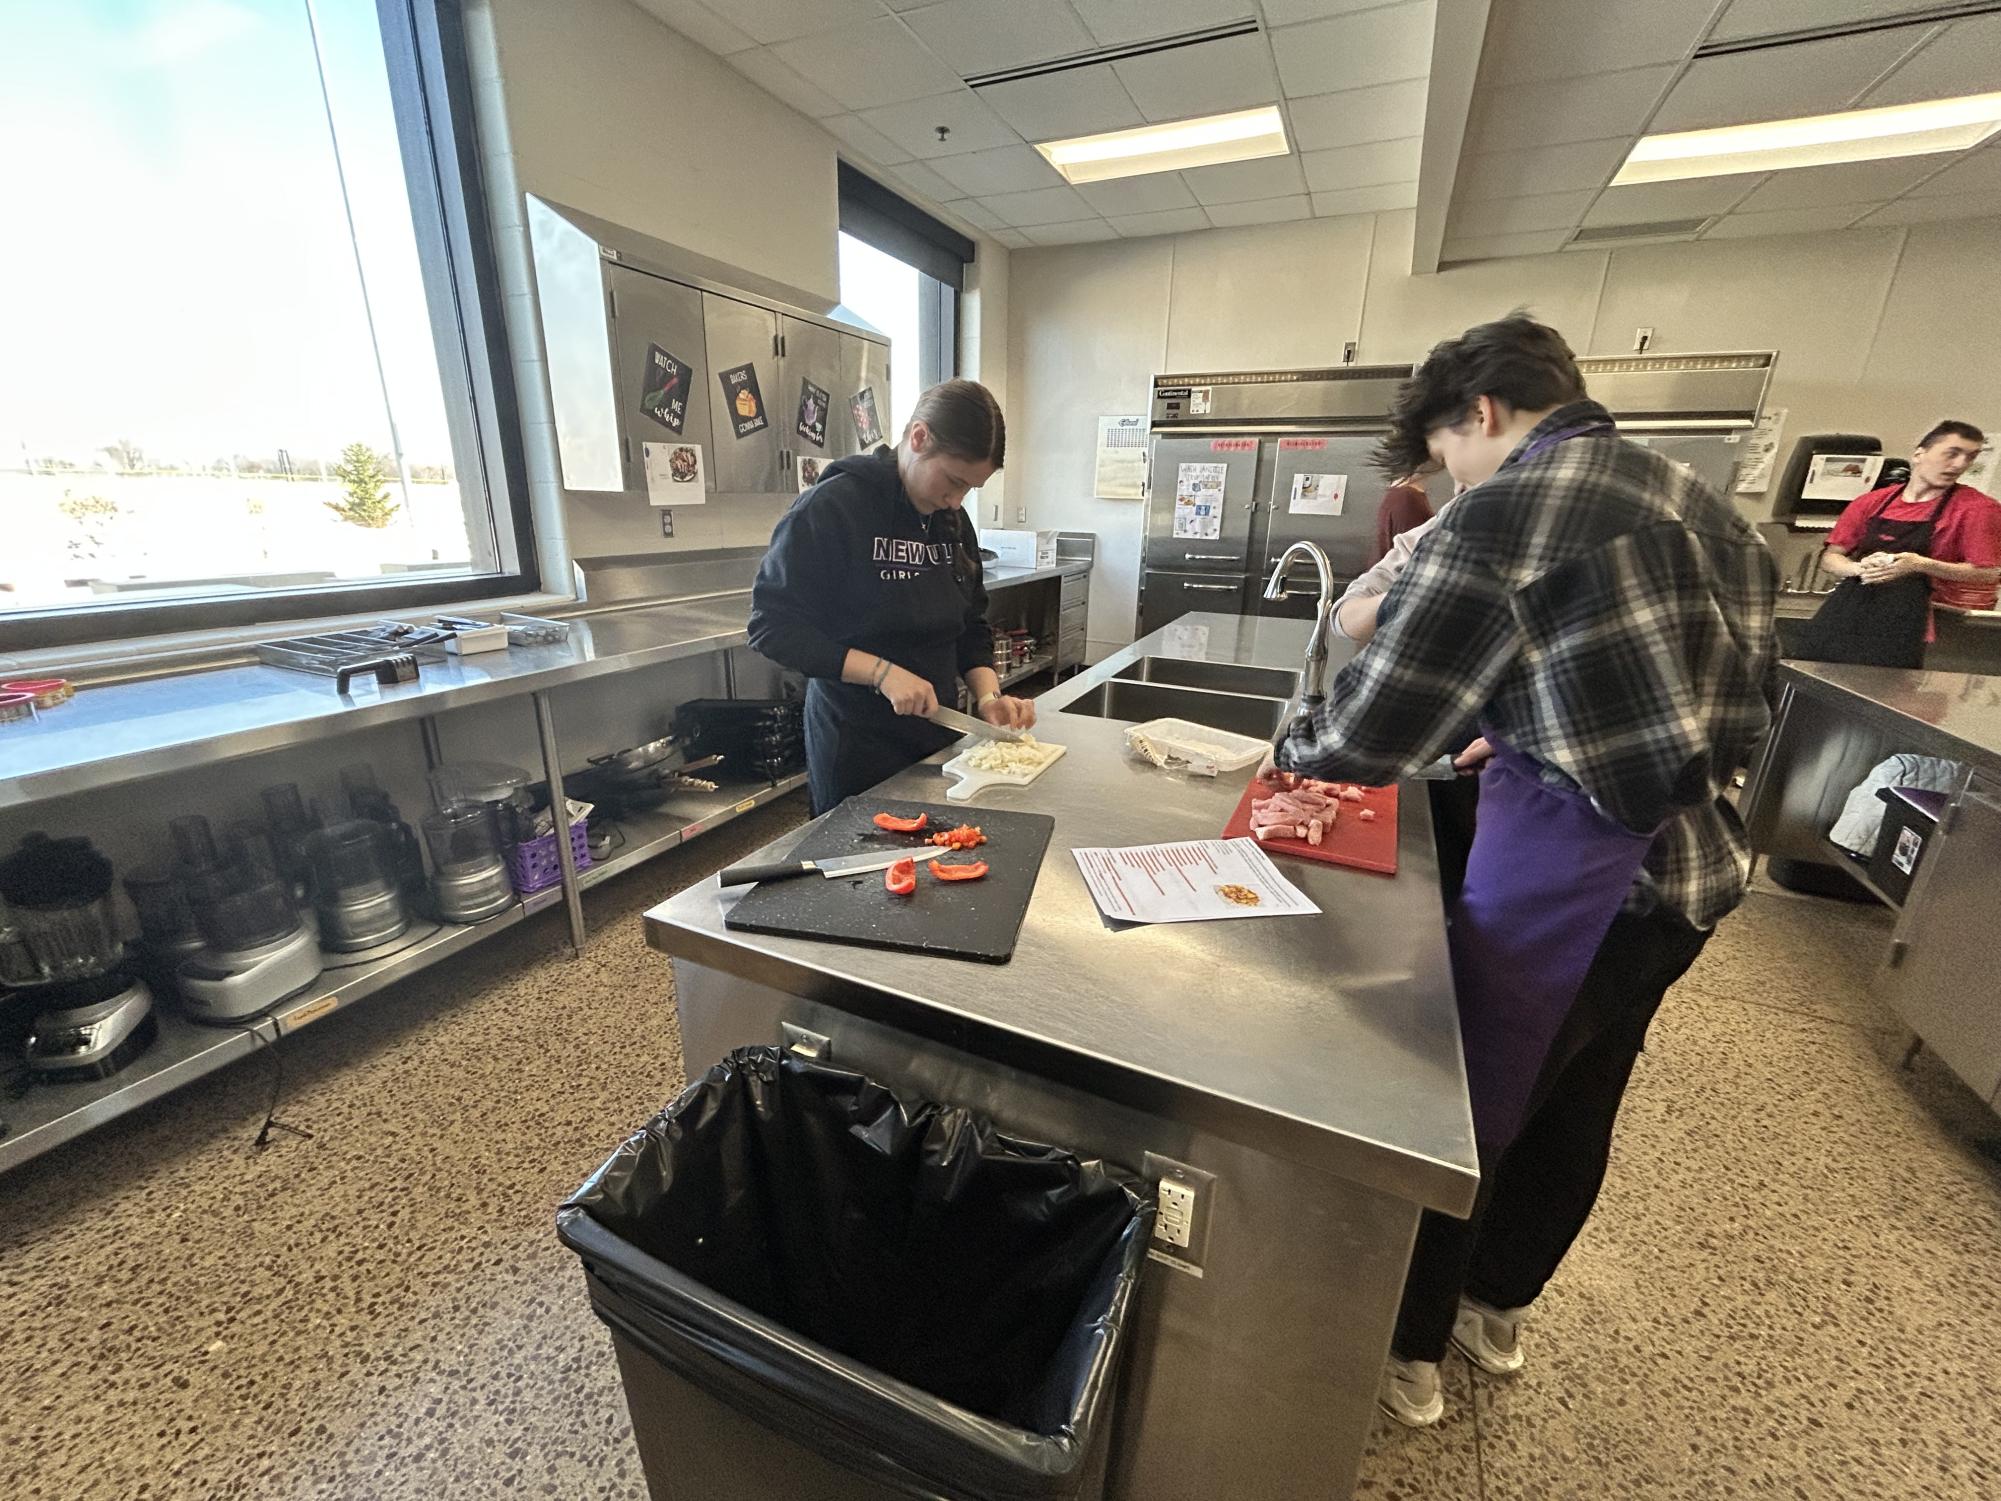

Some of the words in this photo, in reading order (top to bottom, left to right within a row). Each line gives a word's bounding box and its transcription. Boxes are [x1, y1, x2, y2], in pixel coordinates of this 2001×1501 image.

[654, 351, 678, 375] WATCH
[654, 406, 681, 427] whip
[671, 398, 683, 415] ME
